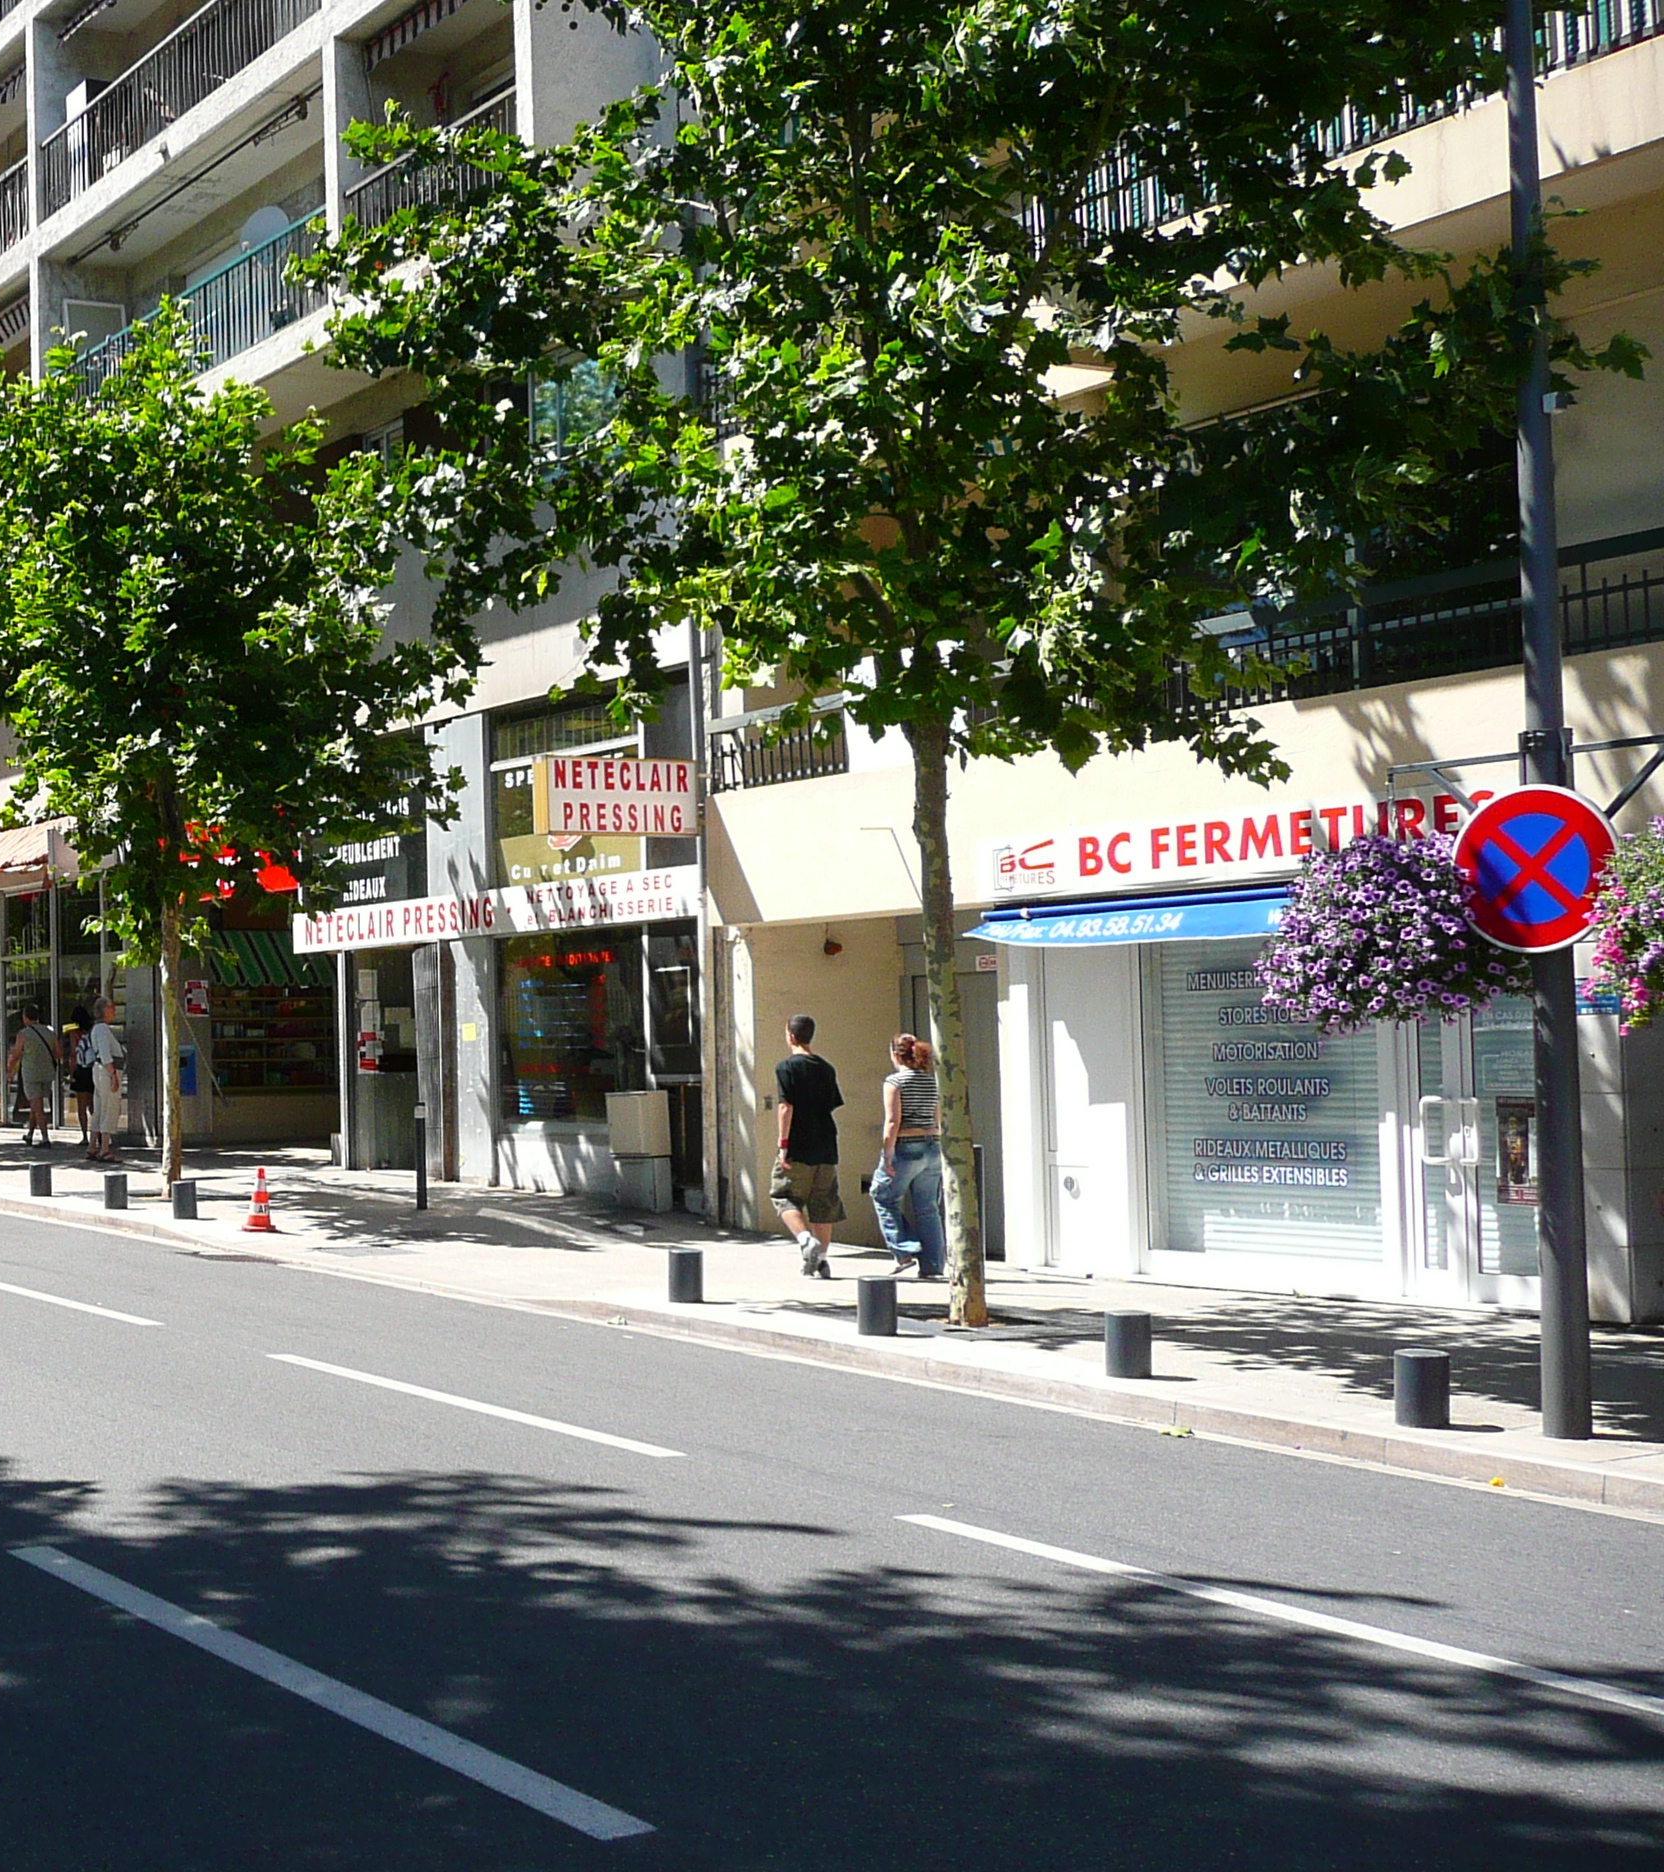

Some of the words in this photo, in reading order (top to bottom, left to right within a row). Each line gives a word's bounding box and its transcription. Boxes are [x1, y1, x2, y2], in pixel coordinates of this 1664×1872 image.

[554, 760, 689, 793] NETECLAIR
[563, 802, 682, 833] PRESSING
[575, 853, 622, 873] Daim
[1078, 832, 1132, 878] BC
[526, 880, 618, 904] NETTOYAGE
[626, 879, 635, 893] A
[642, 874, 672, 891] SEC
[305, 908, 394, 946] NETECLAIR
[403, 896, 493, 936] PRESSING
[548, 896, 673, 923] BLANCHISSERIE
[1049, 911, 1185, 937] 04.93.58.51.34
[1219, 1006, 1268, 1025] STORES
[1213, 1042, 1318, 1062] MOTORISATION
[1205, 1077, 1254, 1096] VOLETS
[1257, 1077, 1330, 1096] ROULANTS
[1229, 1103, 1240, 1121] &
[1242, 1103, 1307, 1122] BATTANTS
[1194, 1138, 1251, 1157] RIDEAUX
[1255, 1141, 1347, 1161] METALLIQUES
[1194, 1163, 1205, 1181] &
[1207, 1165, 1259, 1183] GRILLES
[1262, 1167, 1348, 1187] EXTENSIBLES
